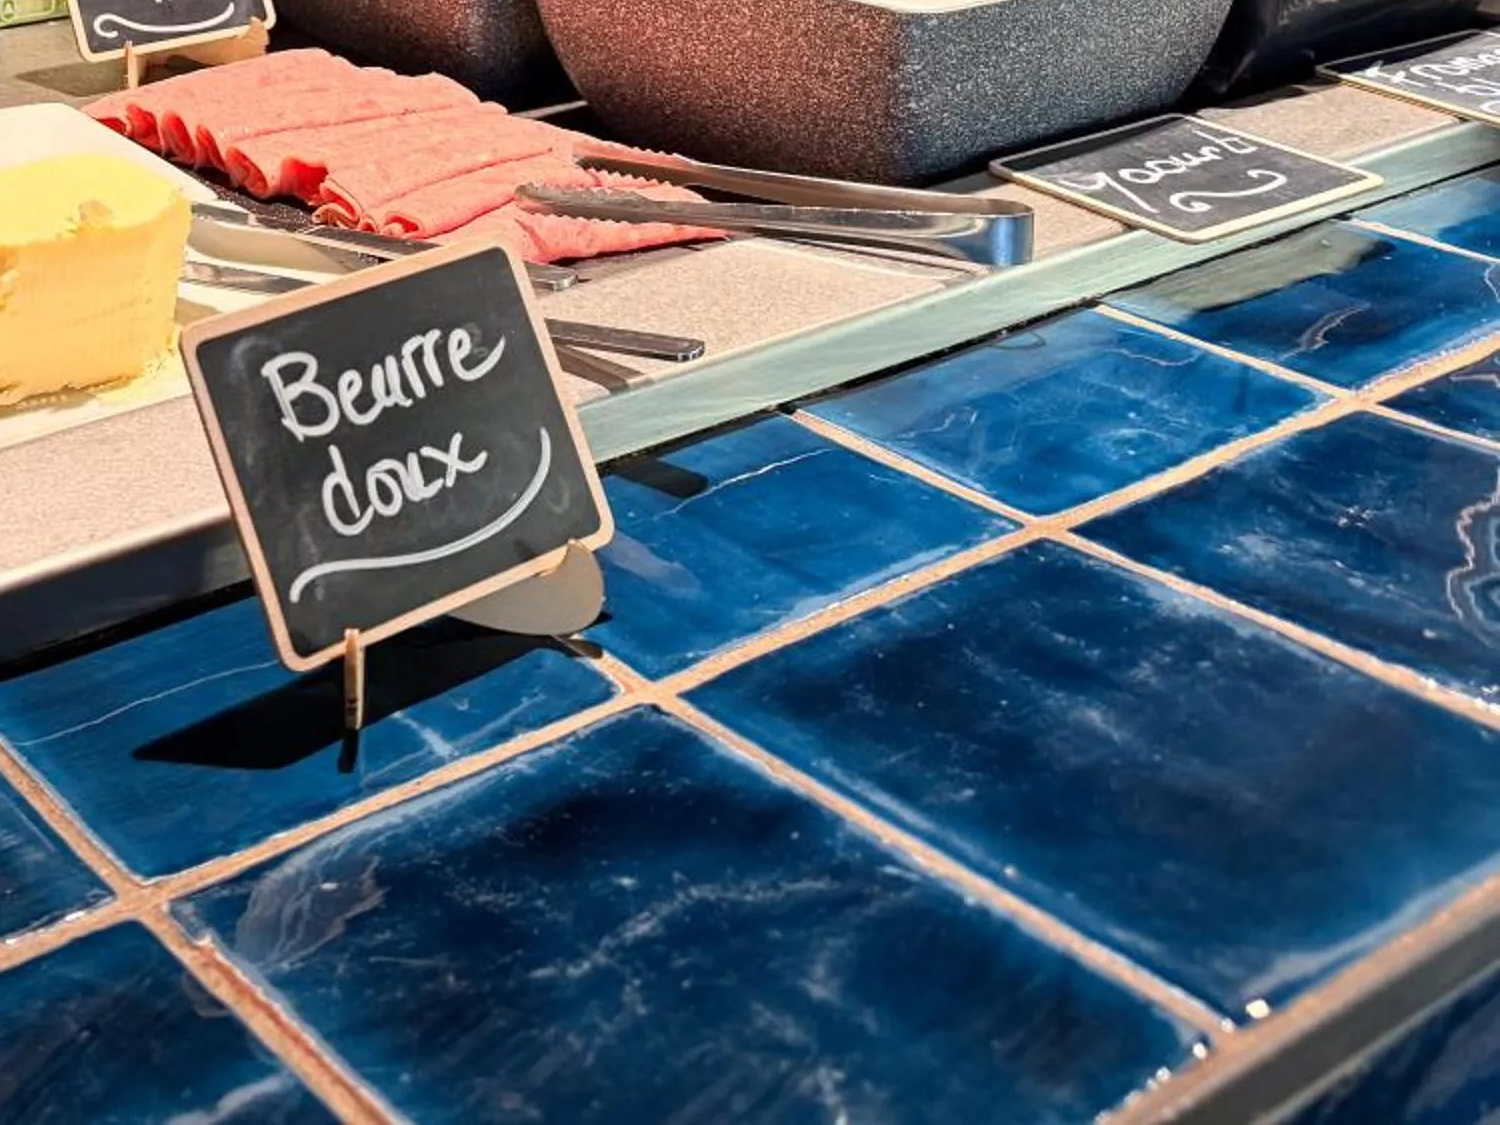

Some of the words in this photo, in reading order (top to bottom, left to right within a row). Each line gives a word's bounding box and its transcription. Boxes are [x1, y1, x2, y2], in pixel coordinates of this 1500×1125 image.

[1057, 128, 1258, 214] Yaourt
[262, 327, 506, 442] Beurre
[321, 431, 489, 537] doux
